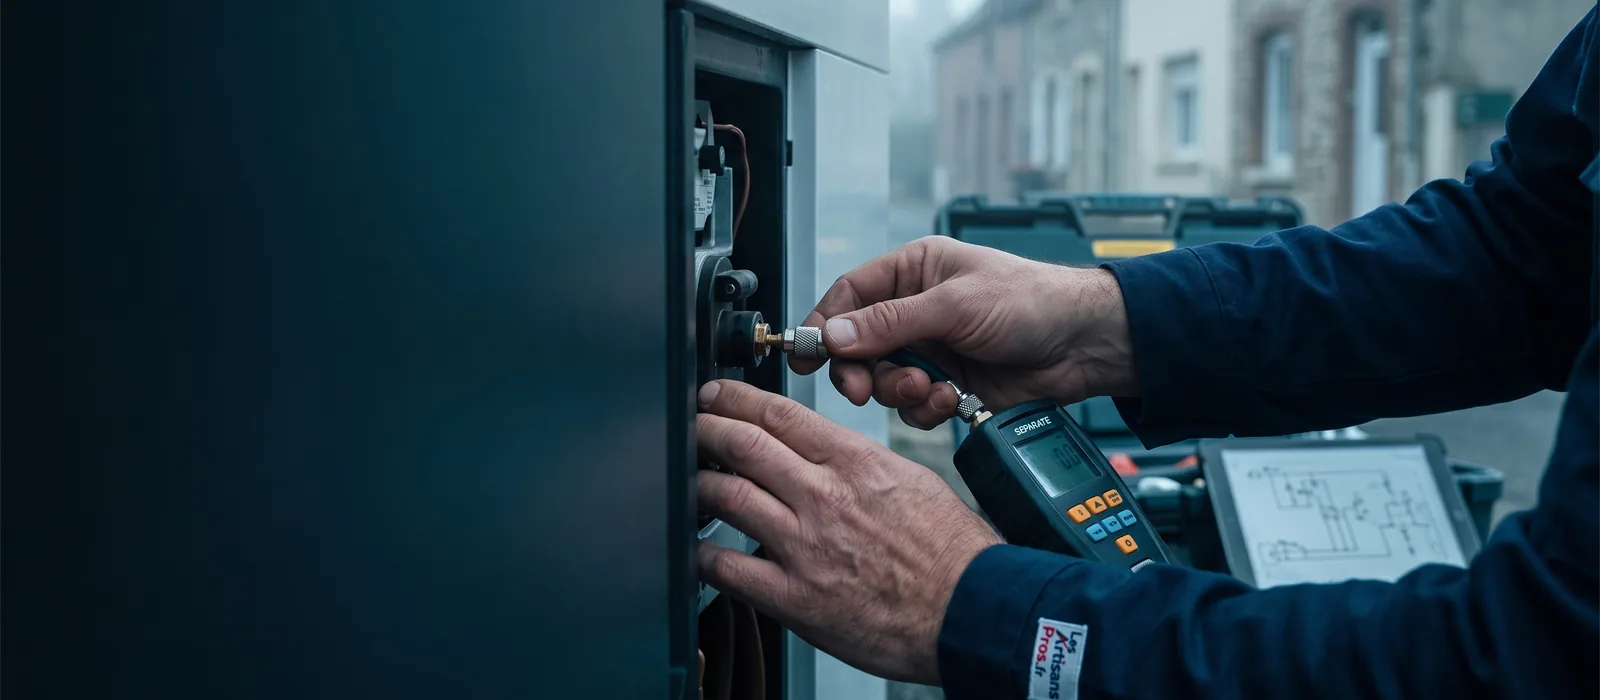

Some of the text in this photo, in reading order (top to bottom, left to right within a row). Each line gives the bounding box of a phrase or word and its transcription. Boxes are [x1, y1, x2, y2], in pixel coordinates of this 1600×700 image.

[1014, 416, 1052, 436] SEPARATE
[1035, 625, 1056, 678] Pros.fr
[1067, 631, 1082, 654] Les
[1049, 629, 1069, 700] Artisans
